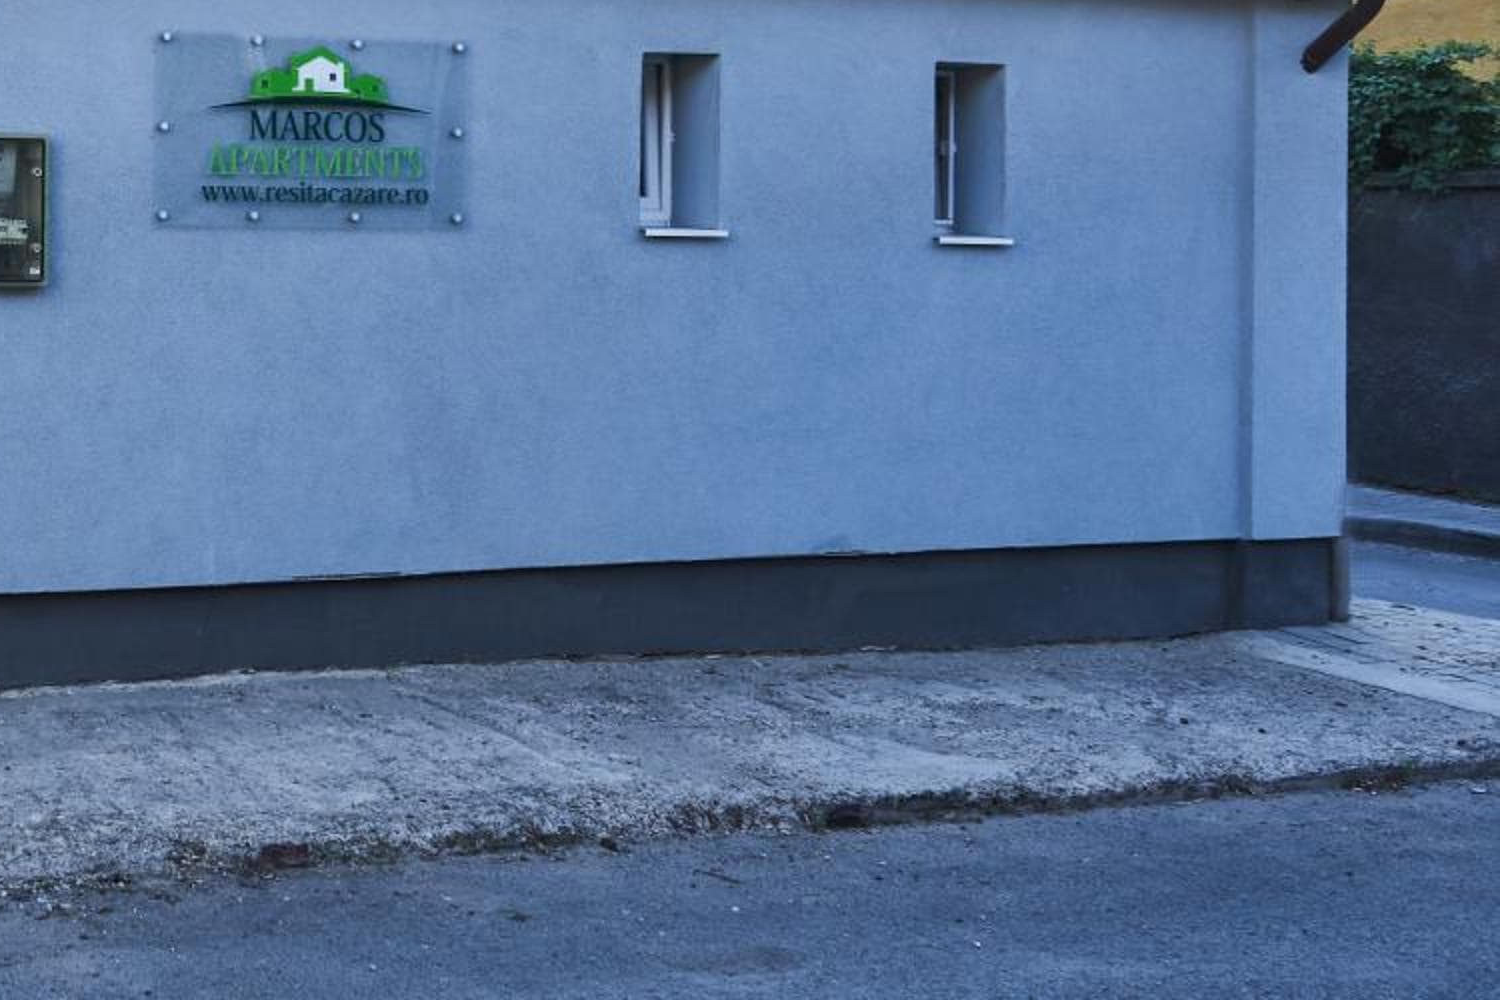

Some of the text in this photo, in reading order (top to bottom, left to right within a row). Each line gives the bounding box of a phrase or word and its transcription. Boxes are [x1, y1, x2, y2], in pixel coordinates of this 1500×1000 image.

[250, 110, 385, 142] MARCOS
[207, 141, 424, 178] APARTMENTS
[201, 182, 429, 205] www.resitacazare.ro
